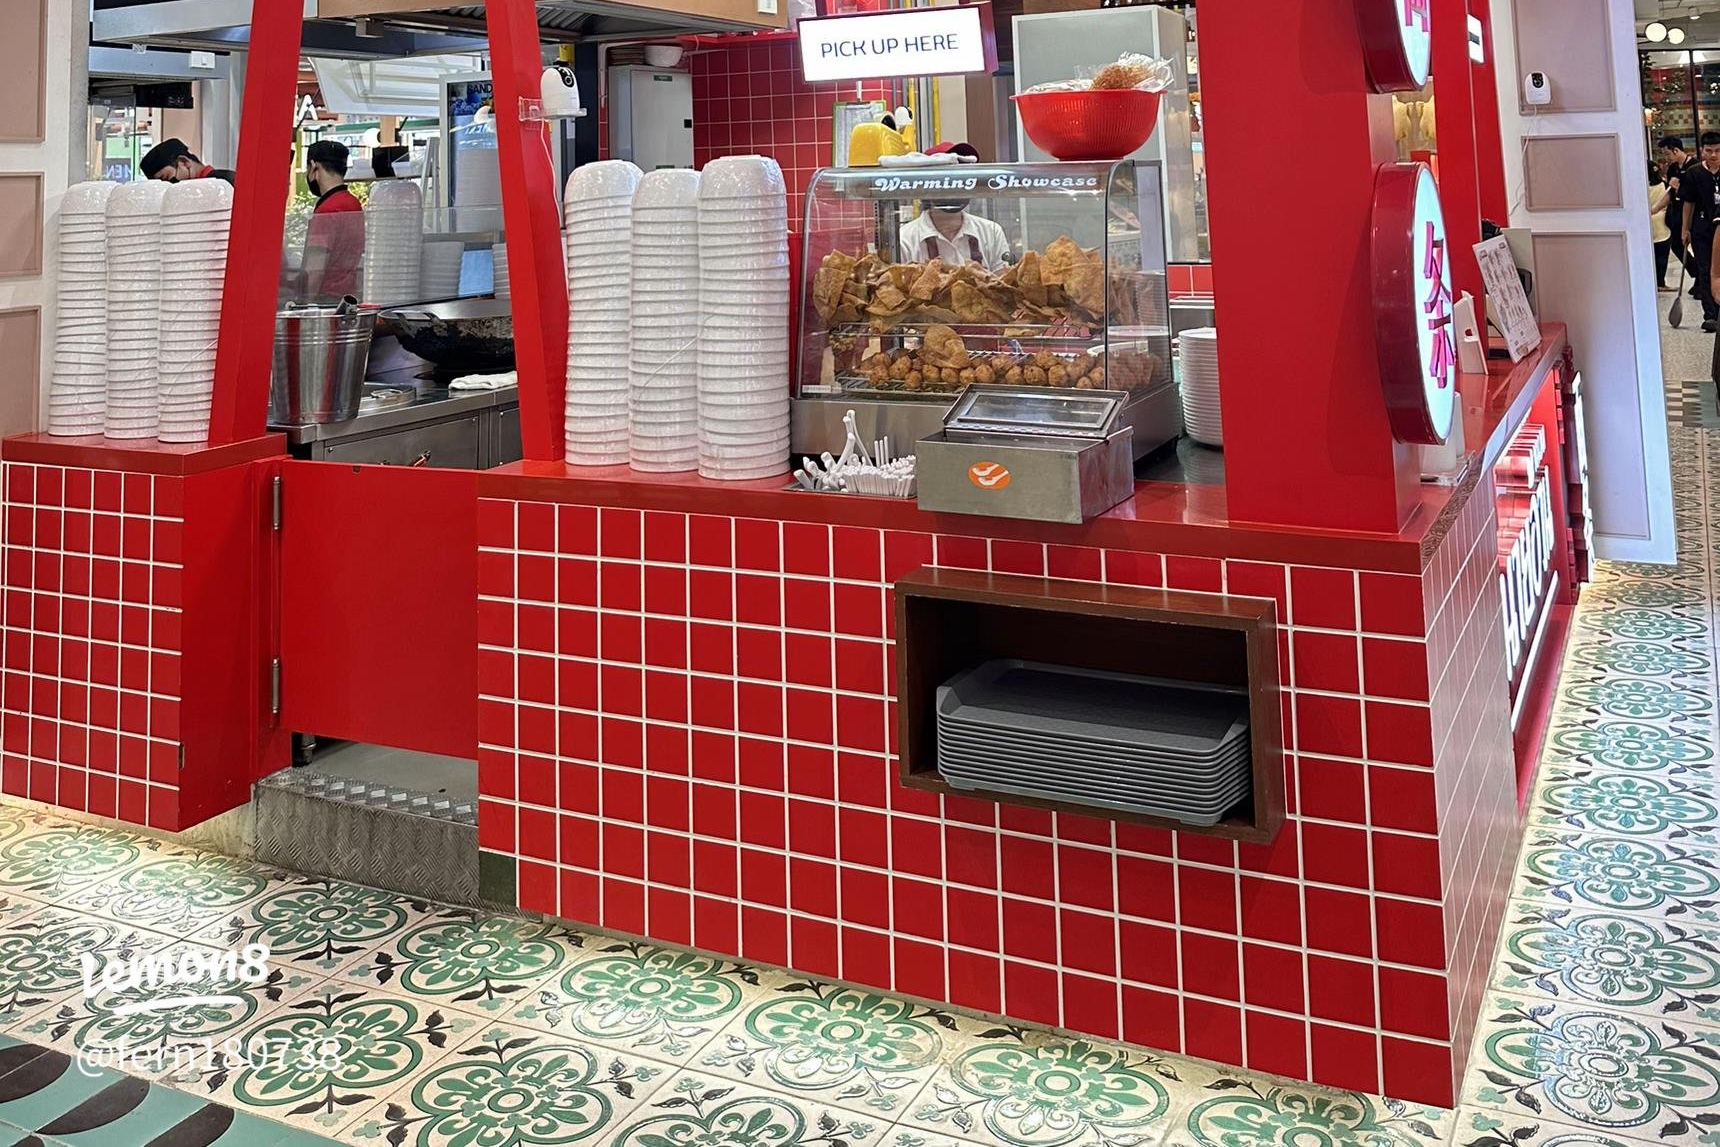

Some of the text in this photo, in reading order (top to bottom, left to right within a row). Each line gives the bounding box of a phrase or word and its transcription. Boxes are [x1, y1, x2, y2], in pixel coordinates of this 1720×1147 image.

[820, 33, 960, 59] PICK UP HERE
[874, 172, 1098, 193] Warming Showcase
